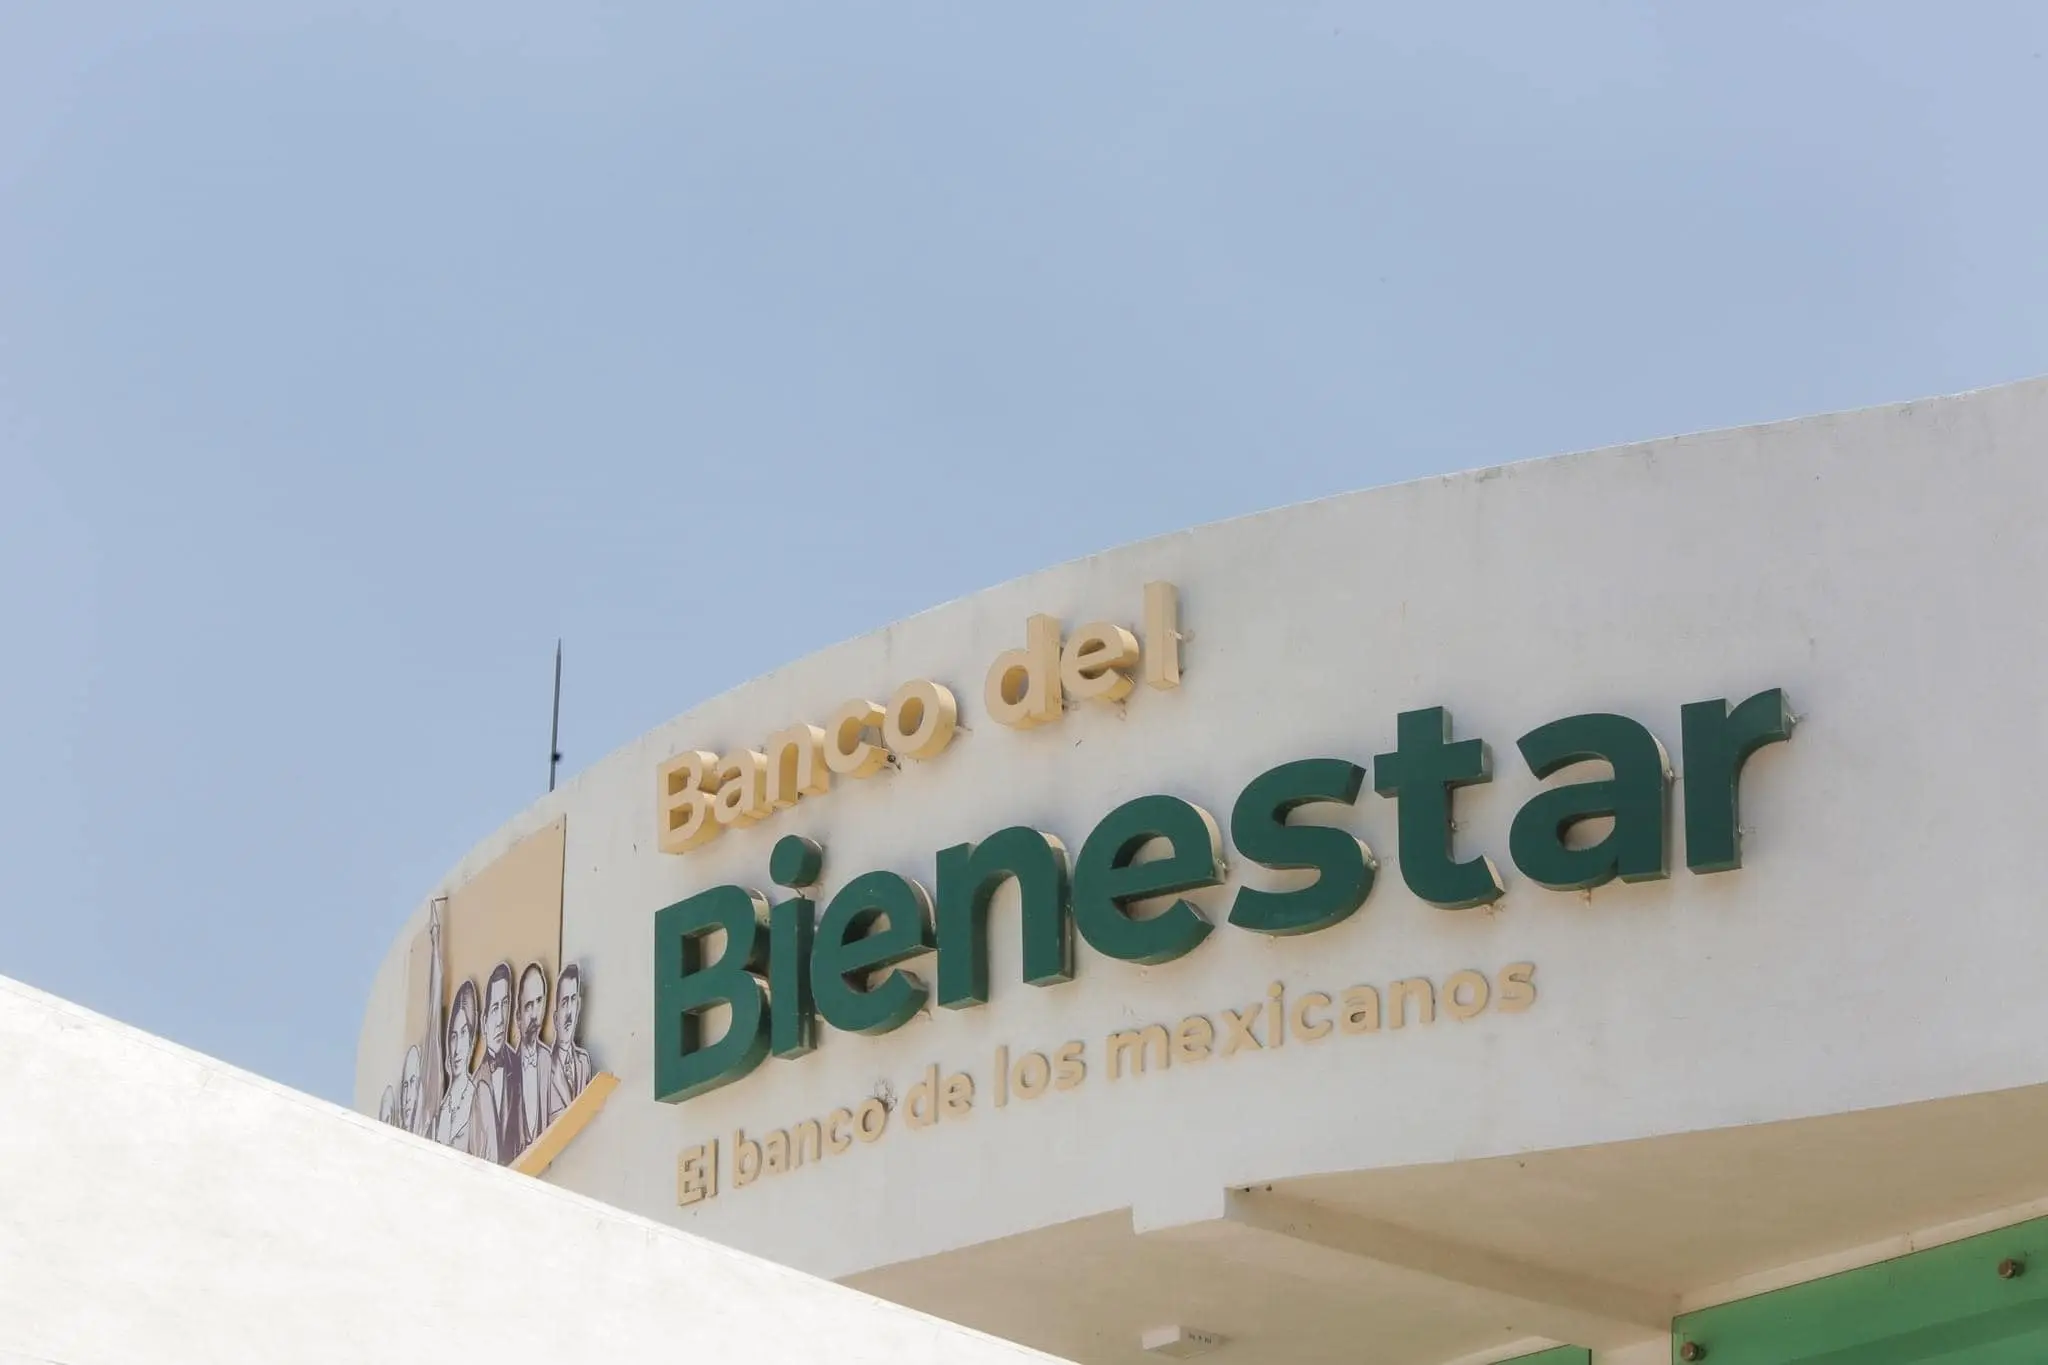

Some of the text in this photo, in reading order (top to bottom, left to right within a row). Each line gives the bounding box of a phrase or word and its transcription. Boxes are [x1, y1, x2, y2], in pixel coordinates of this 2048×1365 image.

[657, 580, 1181, 855] Banco del
[655, 687, 1791, 1104] Bienestar
[677, 961, 1537, 1207] El banco de los mexicanos
